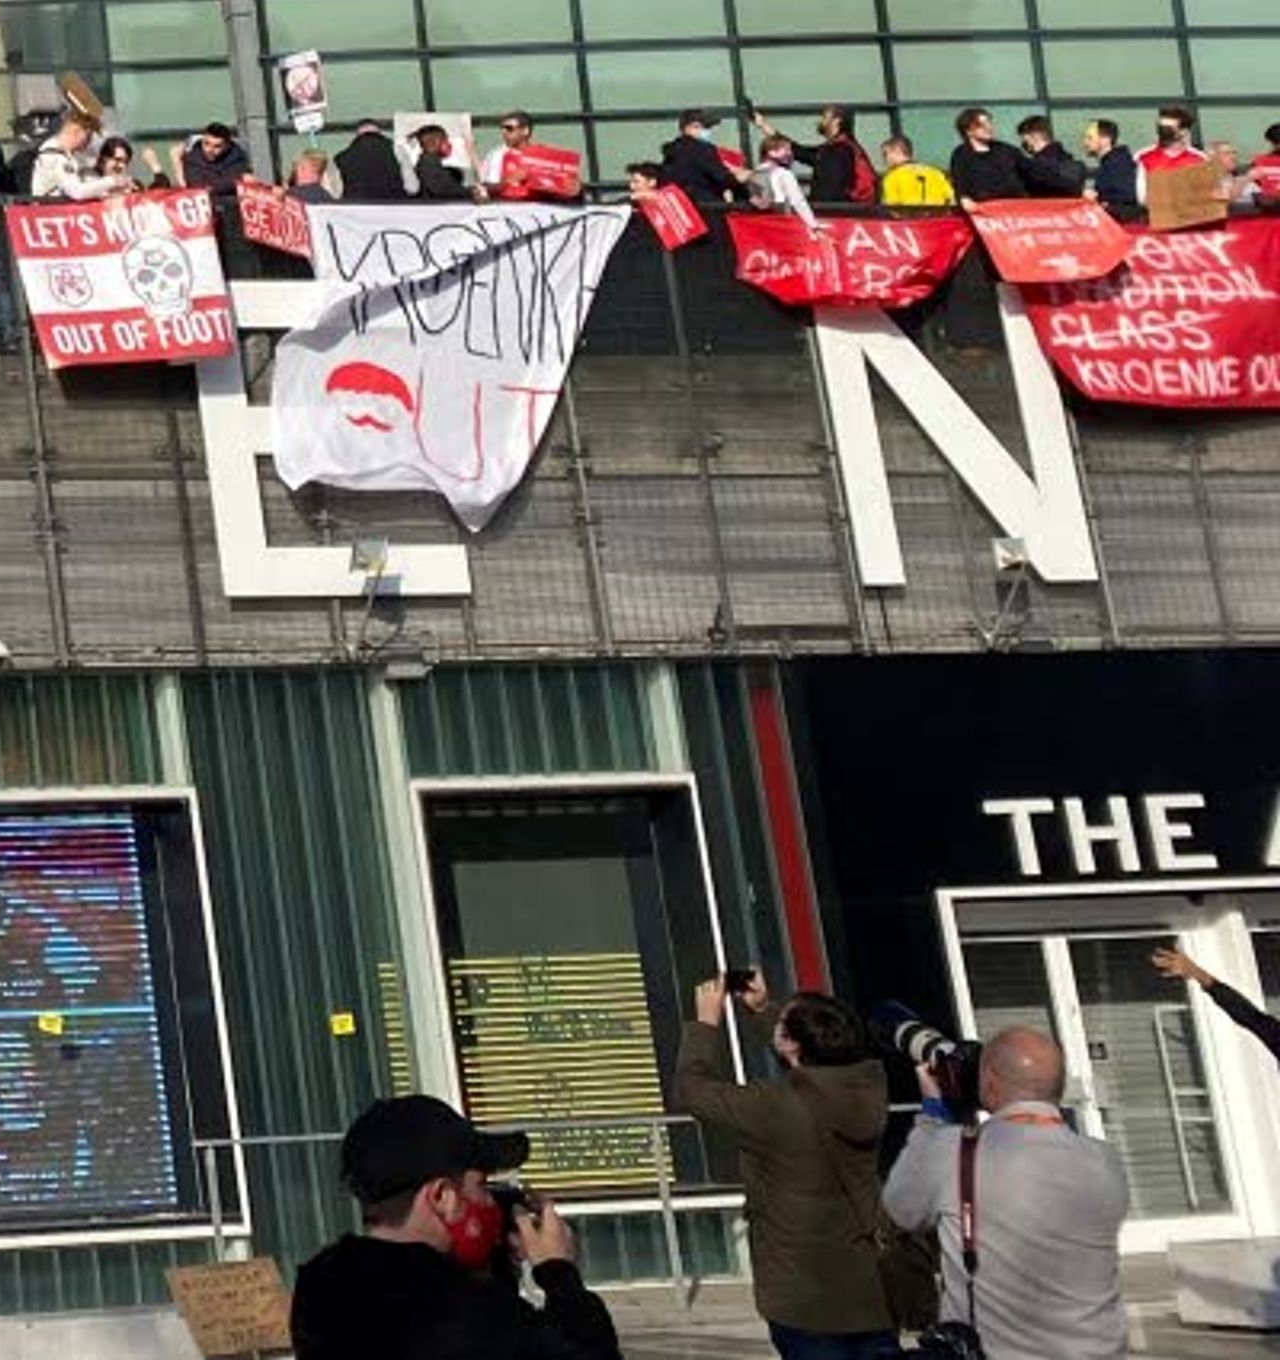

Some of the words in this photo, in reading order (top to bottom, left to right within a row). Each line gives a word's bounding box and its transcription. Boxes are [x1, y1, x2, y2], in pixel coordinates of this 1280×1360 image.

[20, 213, 99, 249] LET'S
[51, 322, 108, 355] OUT
[112, 319, 150, 351] OF
[1050, 309, 1214, 352] CLASS
[1072, 354, 1241, 397] KROENKE
[981, 792, 1220, 876] THE
